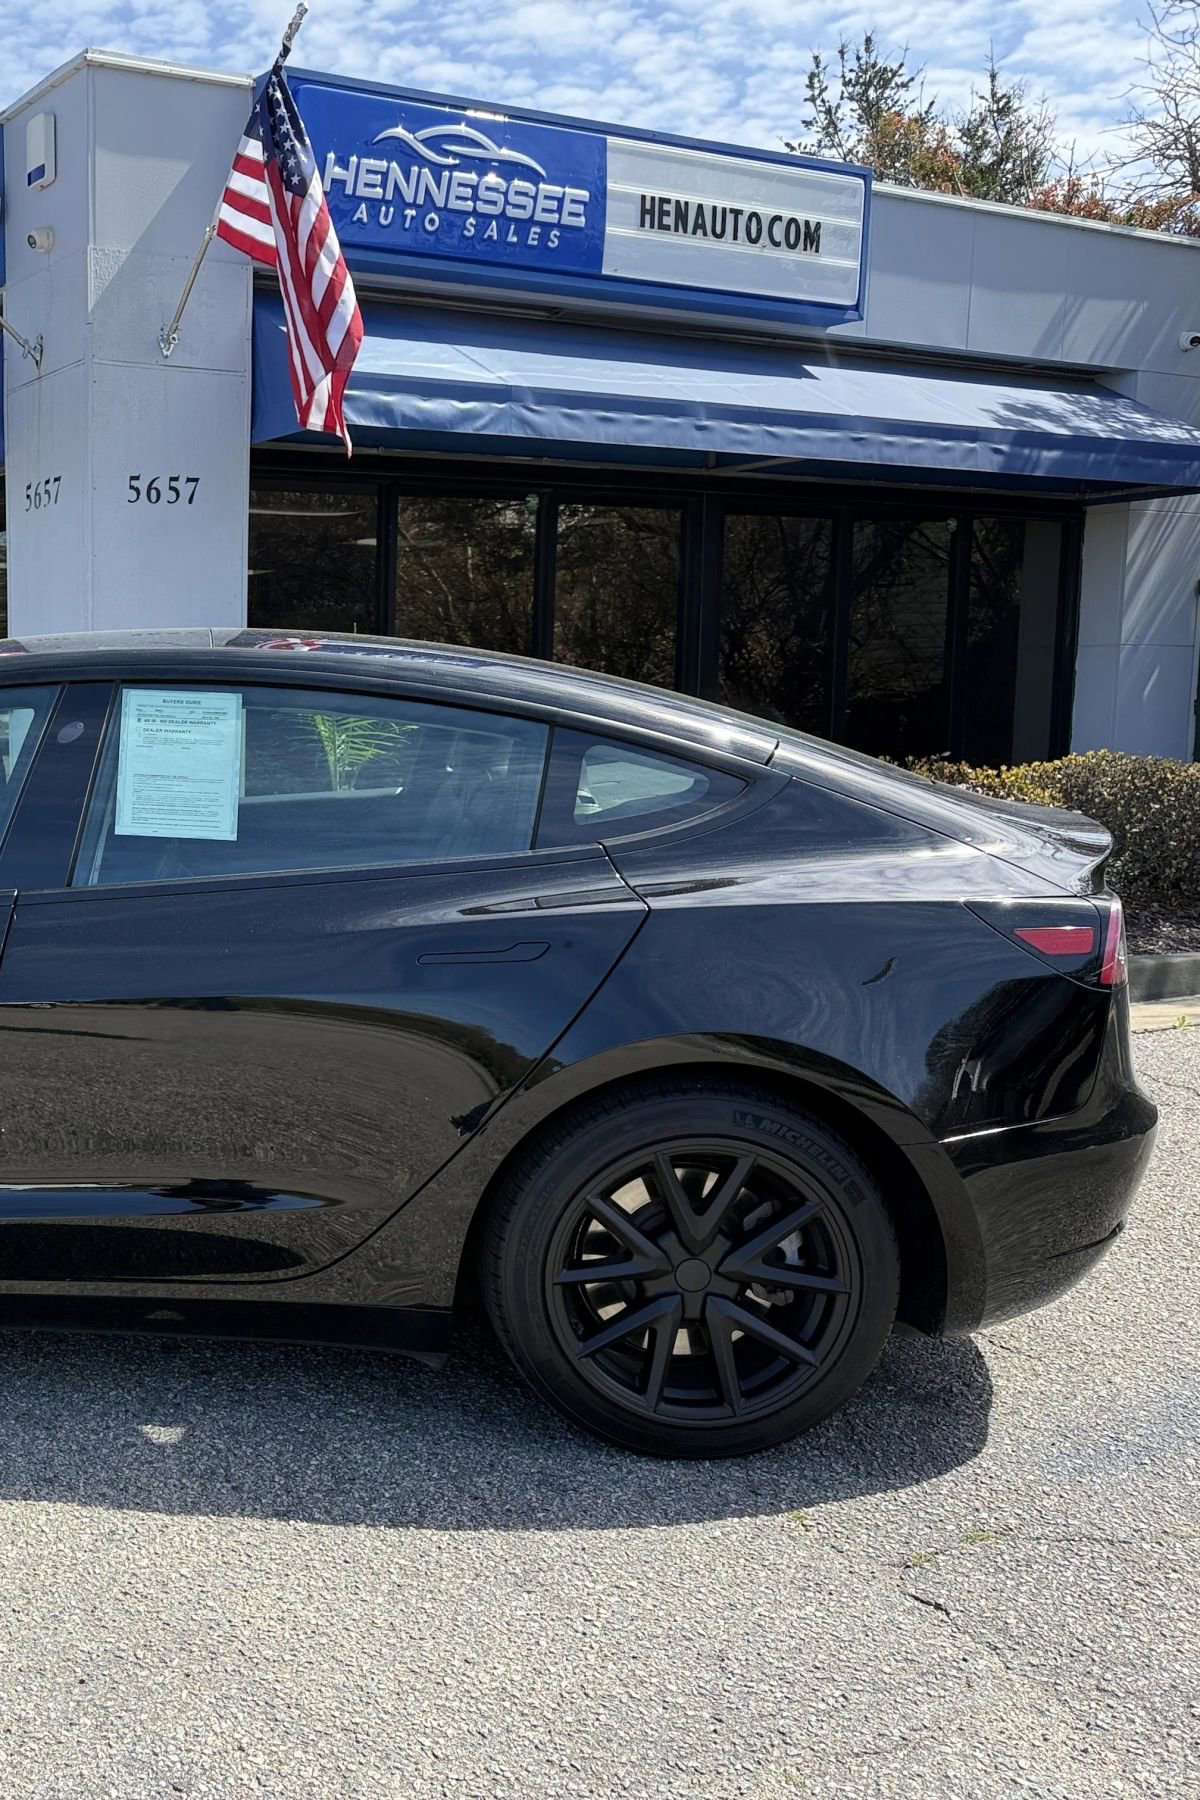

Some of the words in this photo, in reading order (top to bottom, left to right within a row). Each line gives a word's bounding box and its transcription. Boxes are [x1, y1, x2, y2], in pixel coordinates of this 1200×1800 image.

[322, 151, 590, 228] HENNESSEE
[352, 202, 440, 232] AUTO
[463, 216, 561, 248] SALES
[25, 475, 62, 512] 5657
[127, 473, 200, 505] 5657
[758, 1117, 849, 1183] MICHELIN
